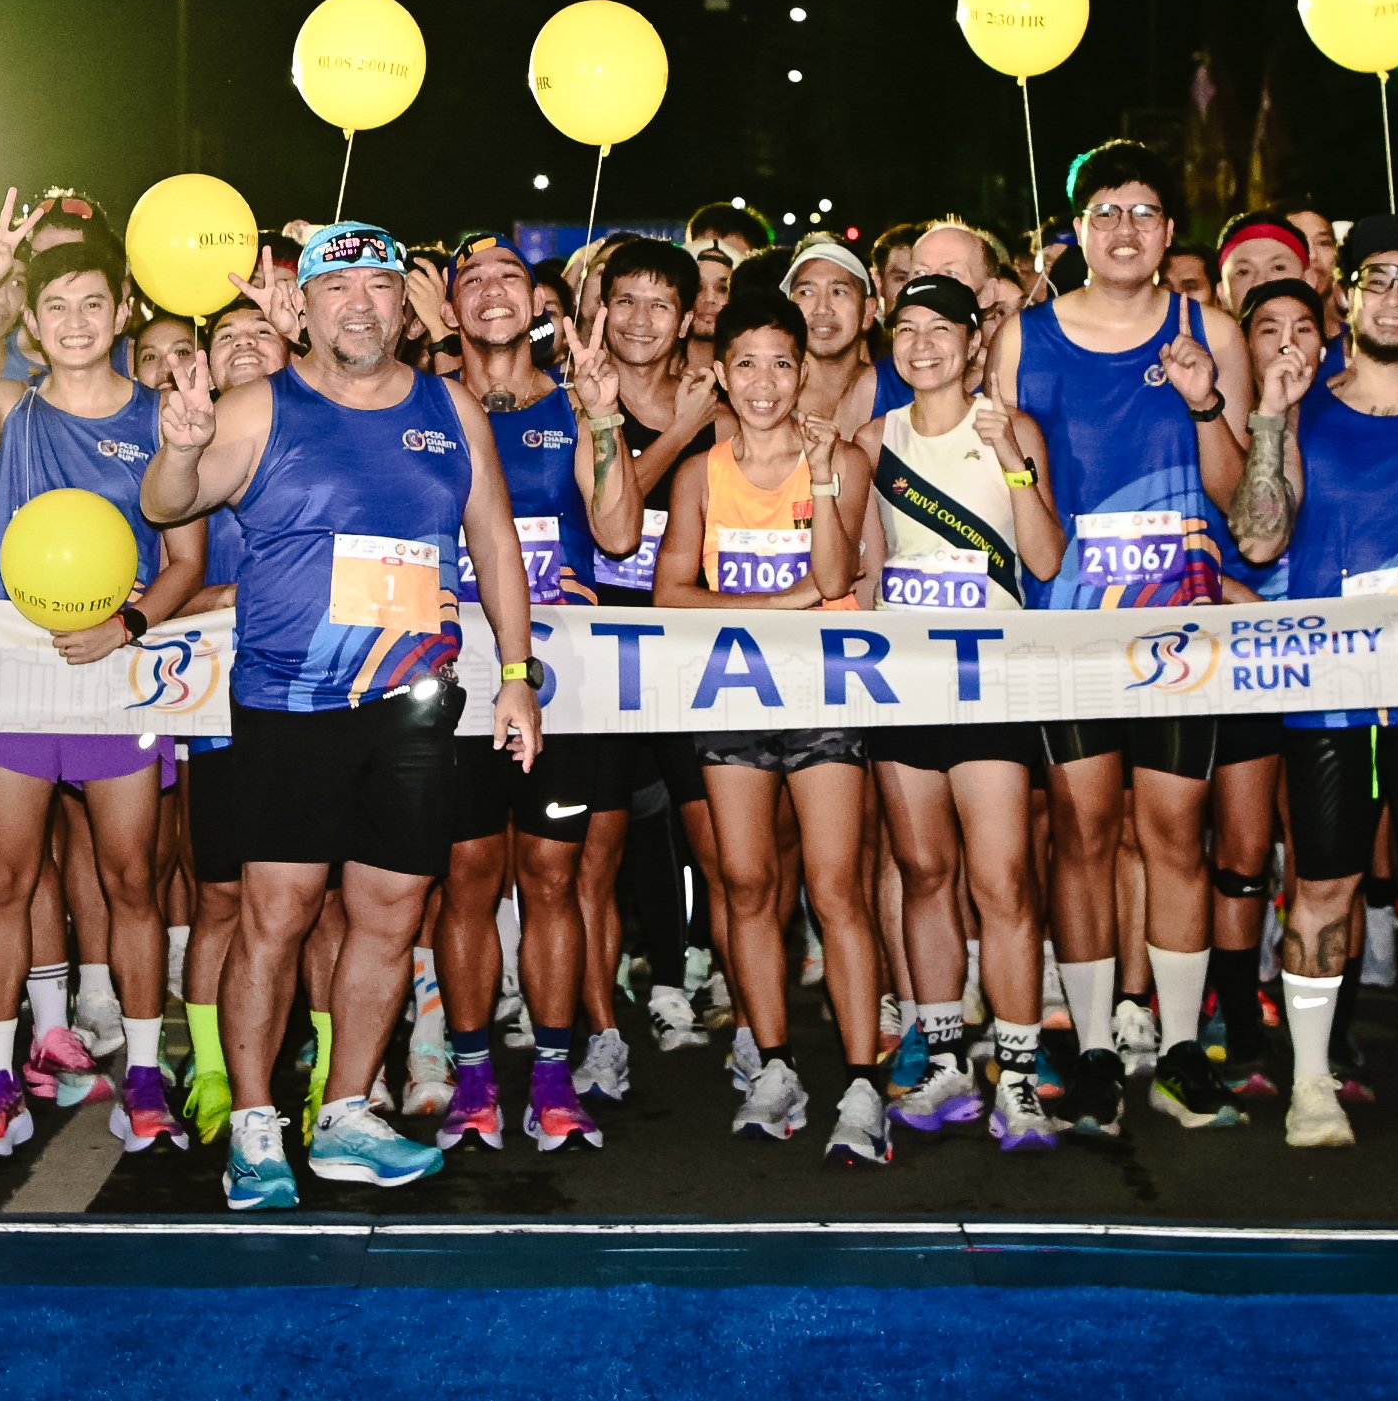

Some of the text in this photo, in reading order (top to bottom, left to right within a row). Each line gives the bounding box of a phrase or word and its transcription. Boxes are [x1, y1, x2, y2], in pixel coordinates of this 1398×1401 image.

[1021, 15, 1045, 28] HR
[536, 76, 552, 90] HR
[937, 509, 995, 555] COACHING
[1085, 543, 1178, 573] 21067
[385, 574, 395, 601] 1
[722, 561, 807, 588] 21061
[887, 576, 980, 607] 20210
[52, 601, 84, 612] 2:00
[1231, 616, 1326, 635] PCSO
[1230, 627, 1383, 658] CHARITY
[1233, 663, 1311, 690] RUN
